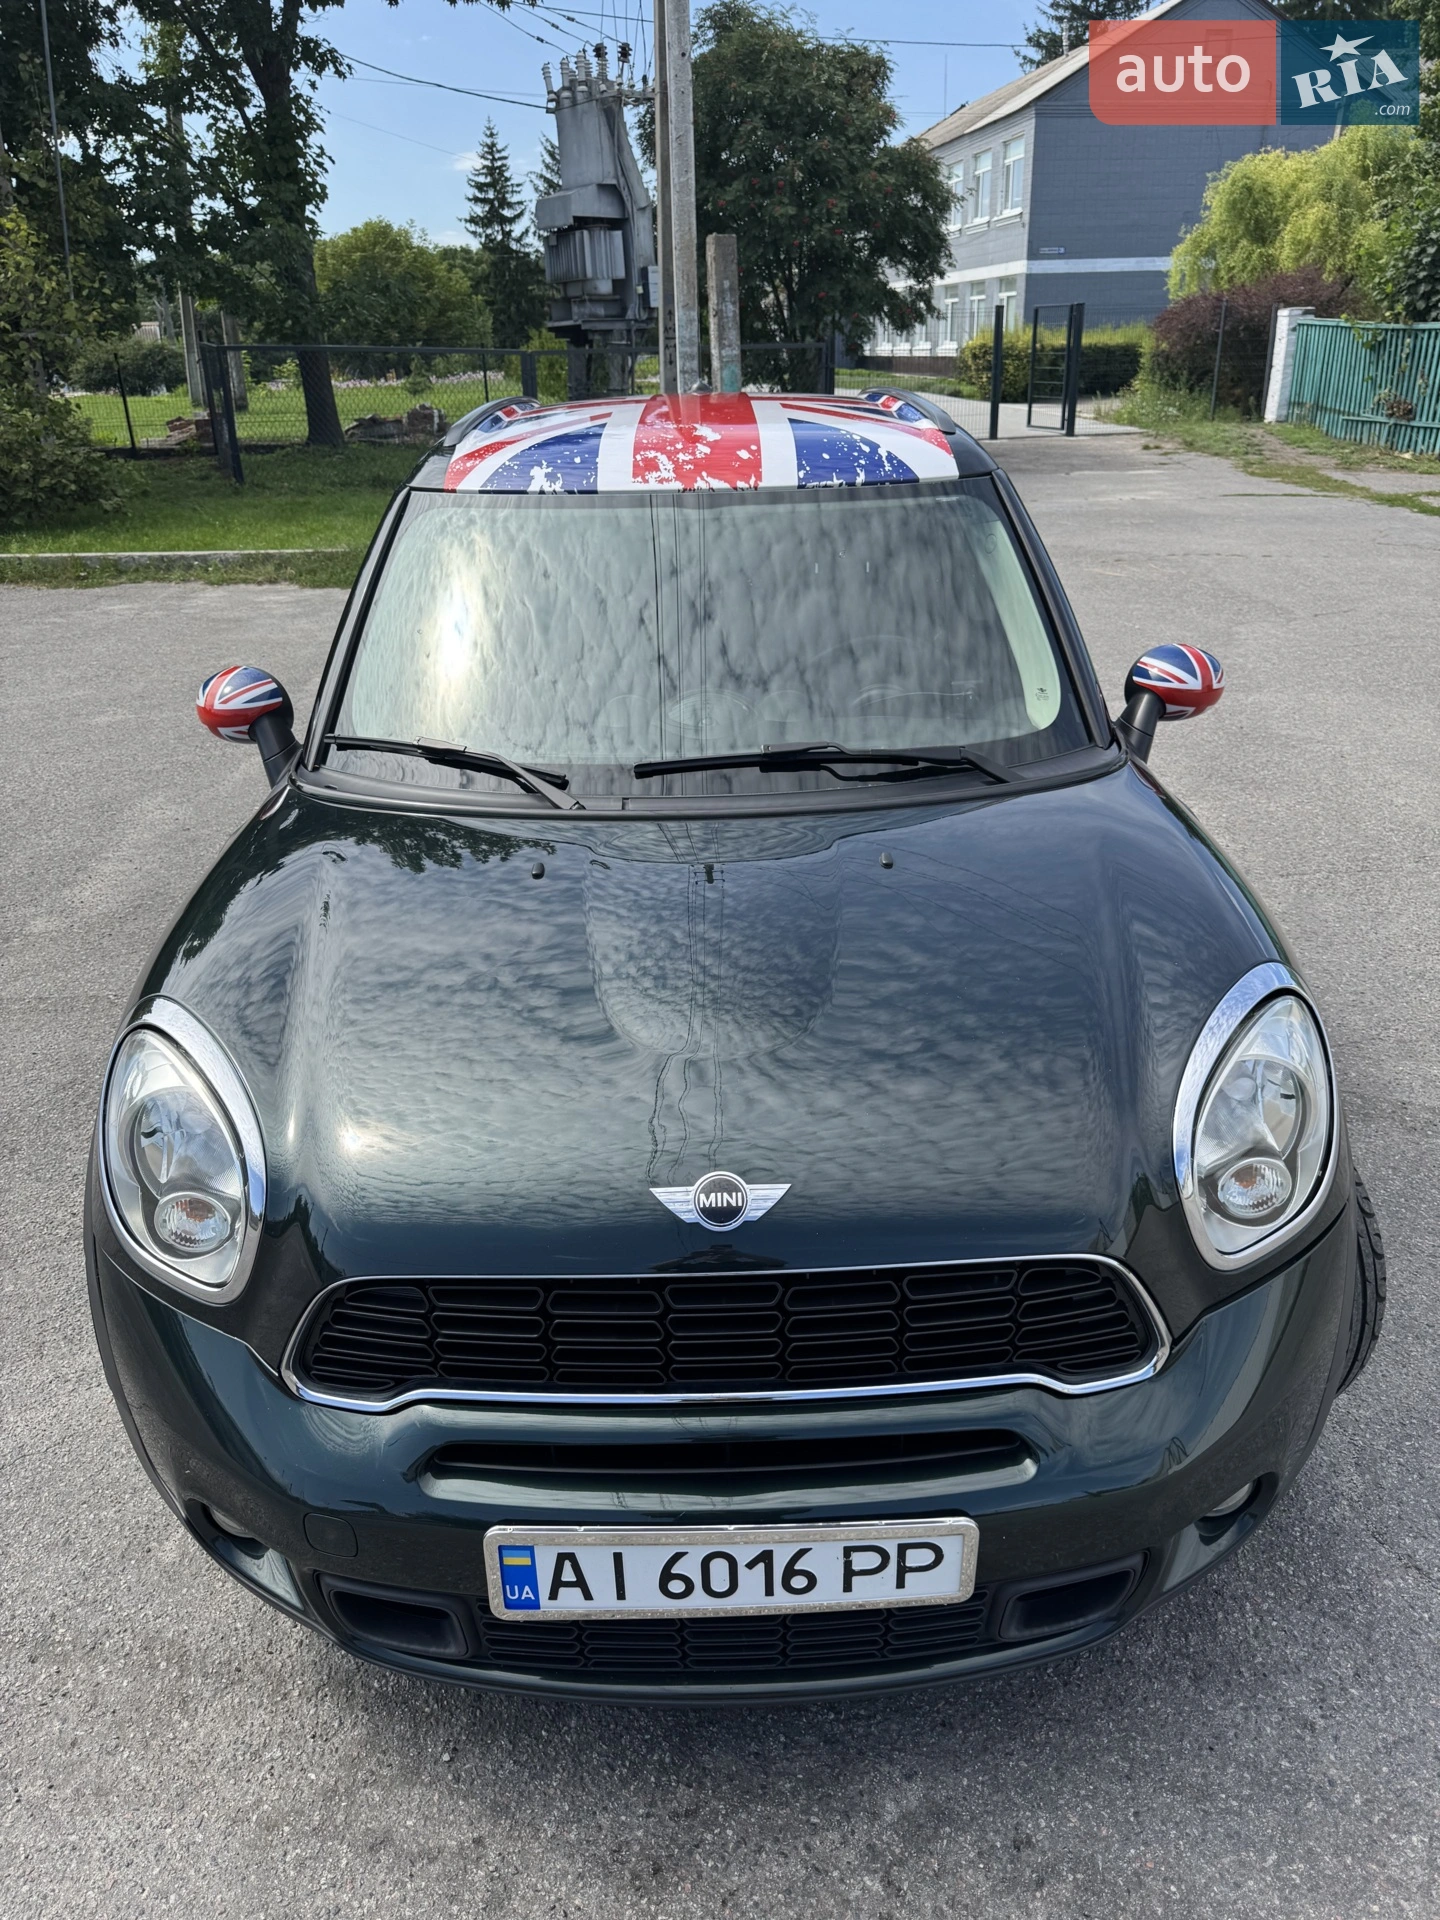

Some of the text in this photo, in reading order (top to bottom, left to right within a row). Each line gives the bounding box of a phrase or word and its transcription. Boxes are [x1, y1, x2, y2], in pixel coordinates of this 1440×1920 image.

[699, 1192, 742, 1208] MINI
[547, 1541, 945, 1601] AI 6016 PP
[505, 1584, 536, 1600] UA
